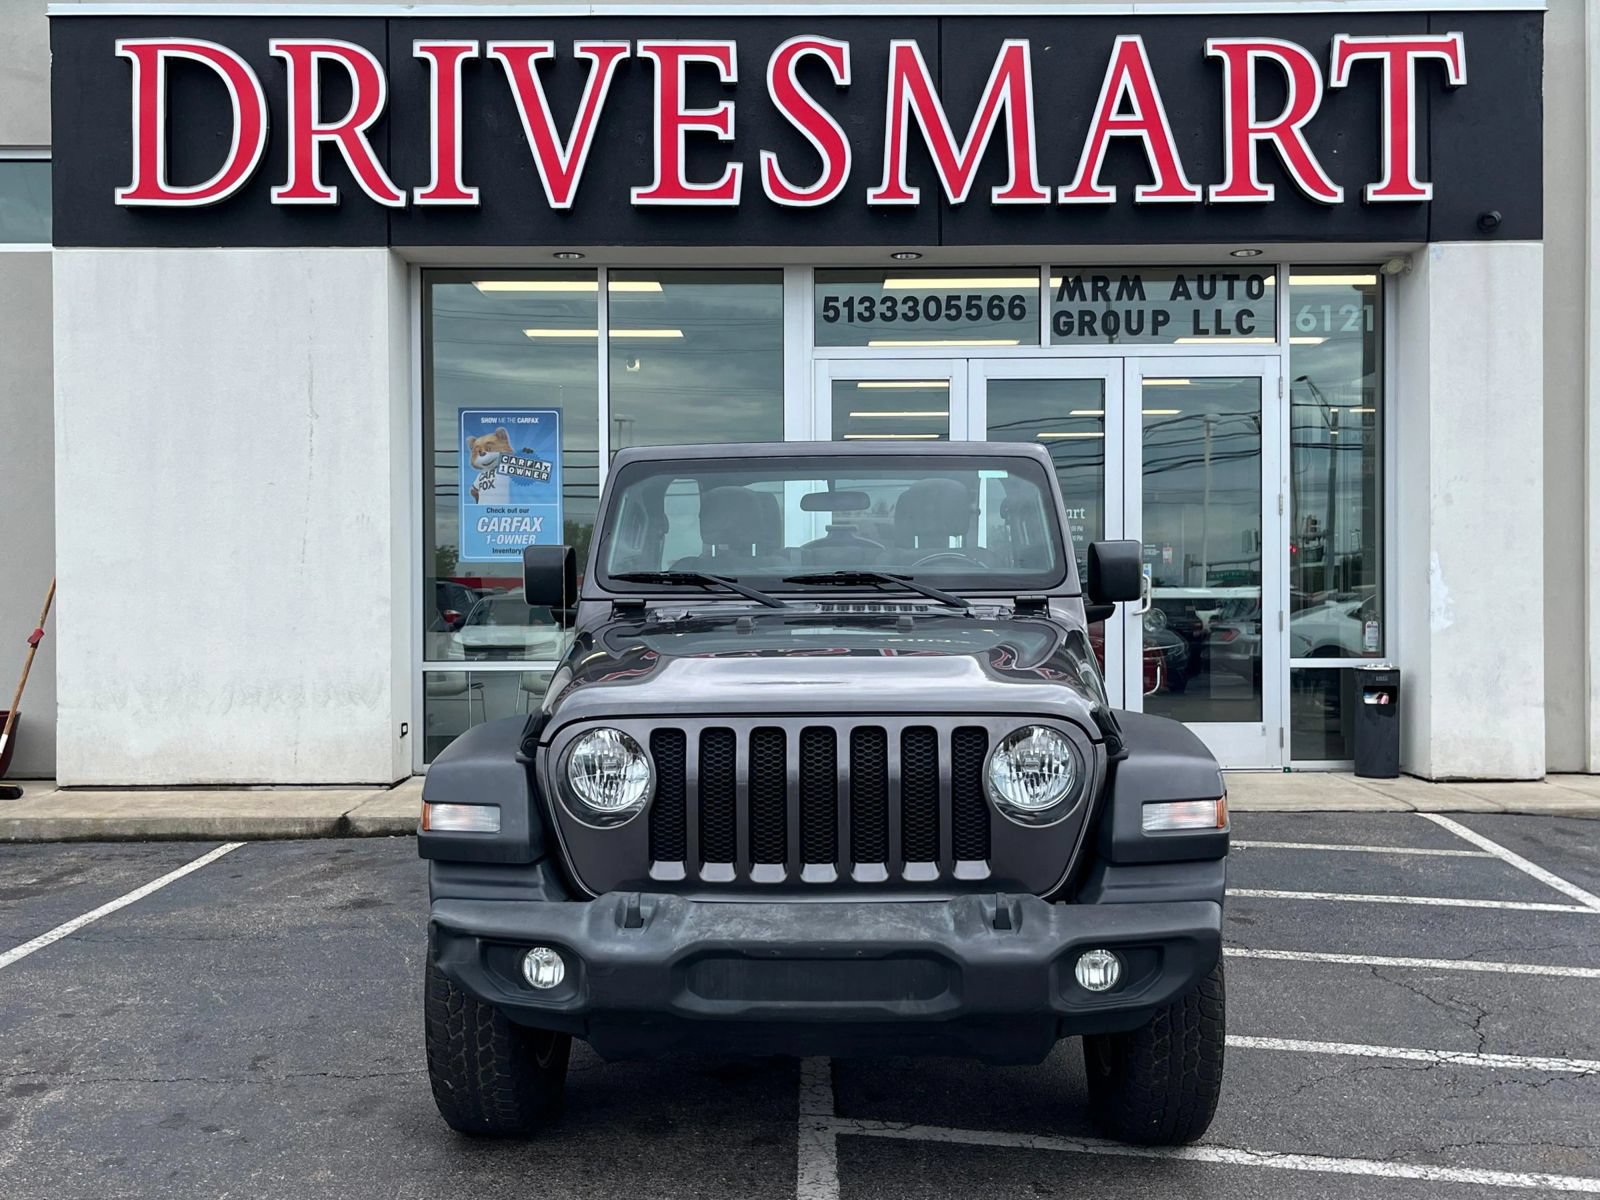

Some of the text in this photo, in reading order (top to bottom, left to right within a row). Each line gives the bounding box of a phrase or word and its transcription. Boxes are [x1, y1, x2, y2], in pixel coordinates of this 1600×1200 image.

[113, 32, 1468, 210] DRIVESMART
[1056, 274, 1265, 302] MRM AUTO
[822, 294, 1027, 323] 5133305566
[1052, 308, 1256, 337] GROUP LLC
[1295, 304, 1374, 332] 6121
[501, 455, 551, 473] CARFAX
[508, 466, 549, 481] OWNER
[478, 479, 496, 491] FOX
[486, 506, 506, 514] Check
[477, 516, 543, 532] CARFAX
[486, 534, 536, 544] 1-OWNER
[492, 547, 524, 555] Inventory
